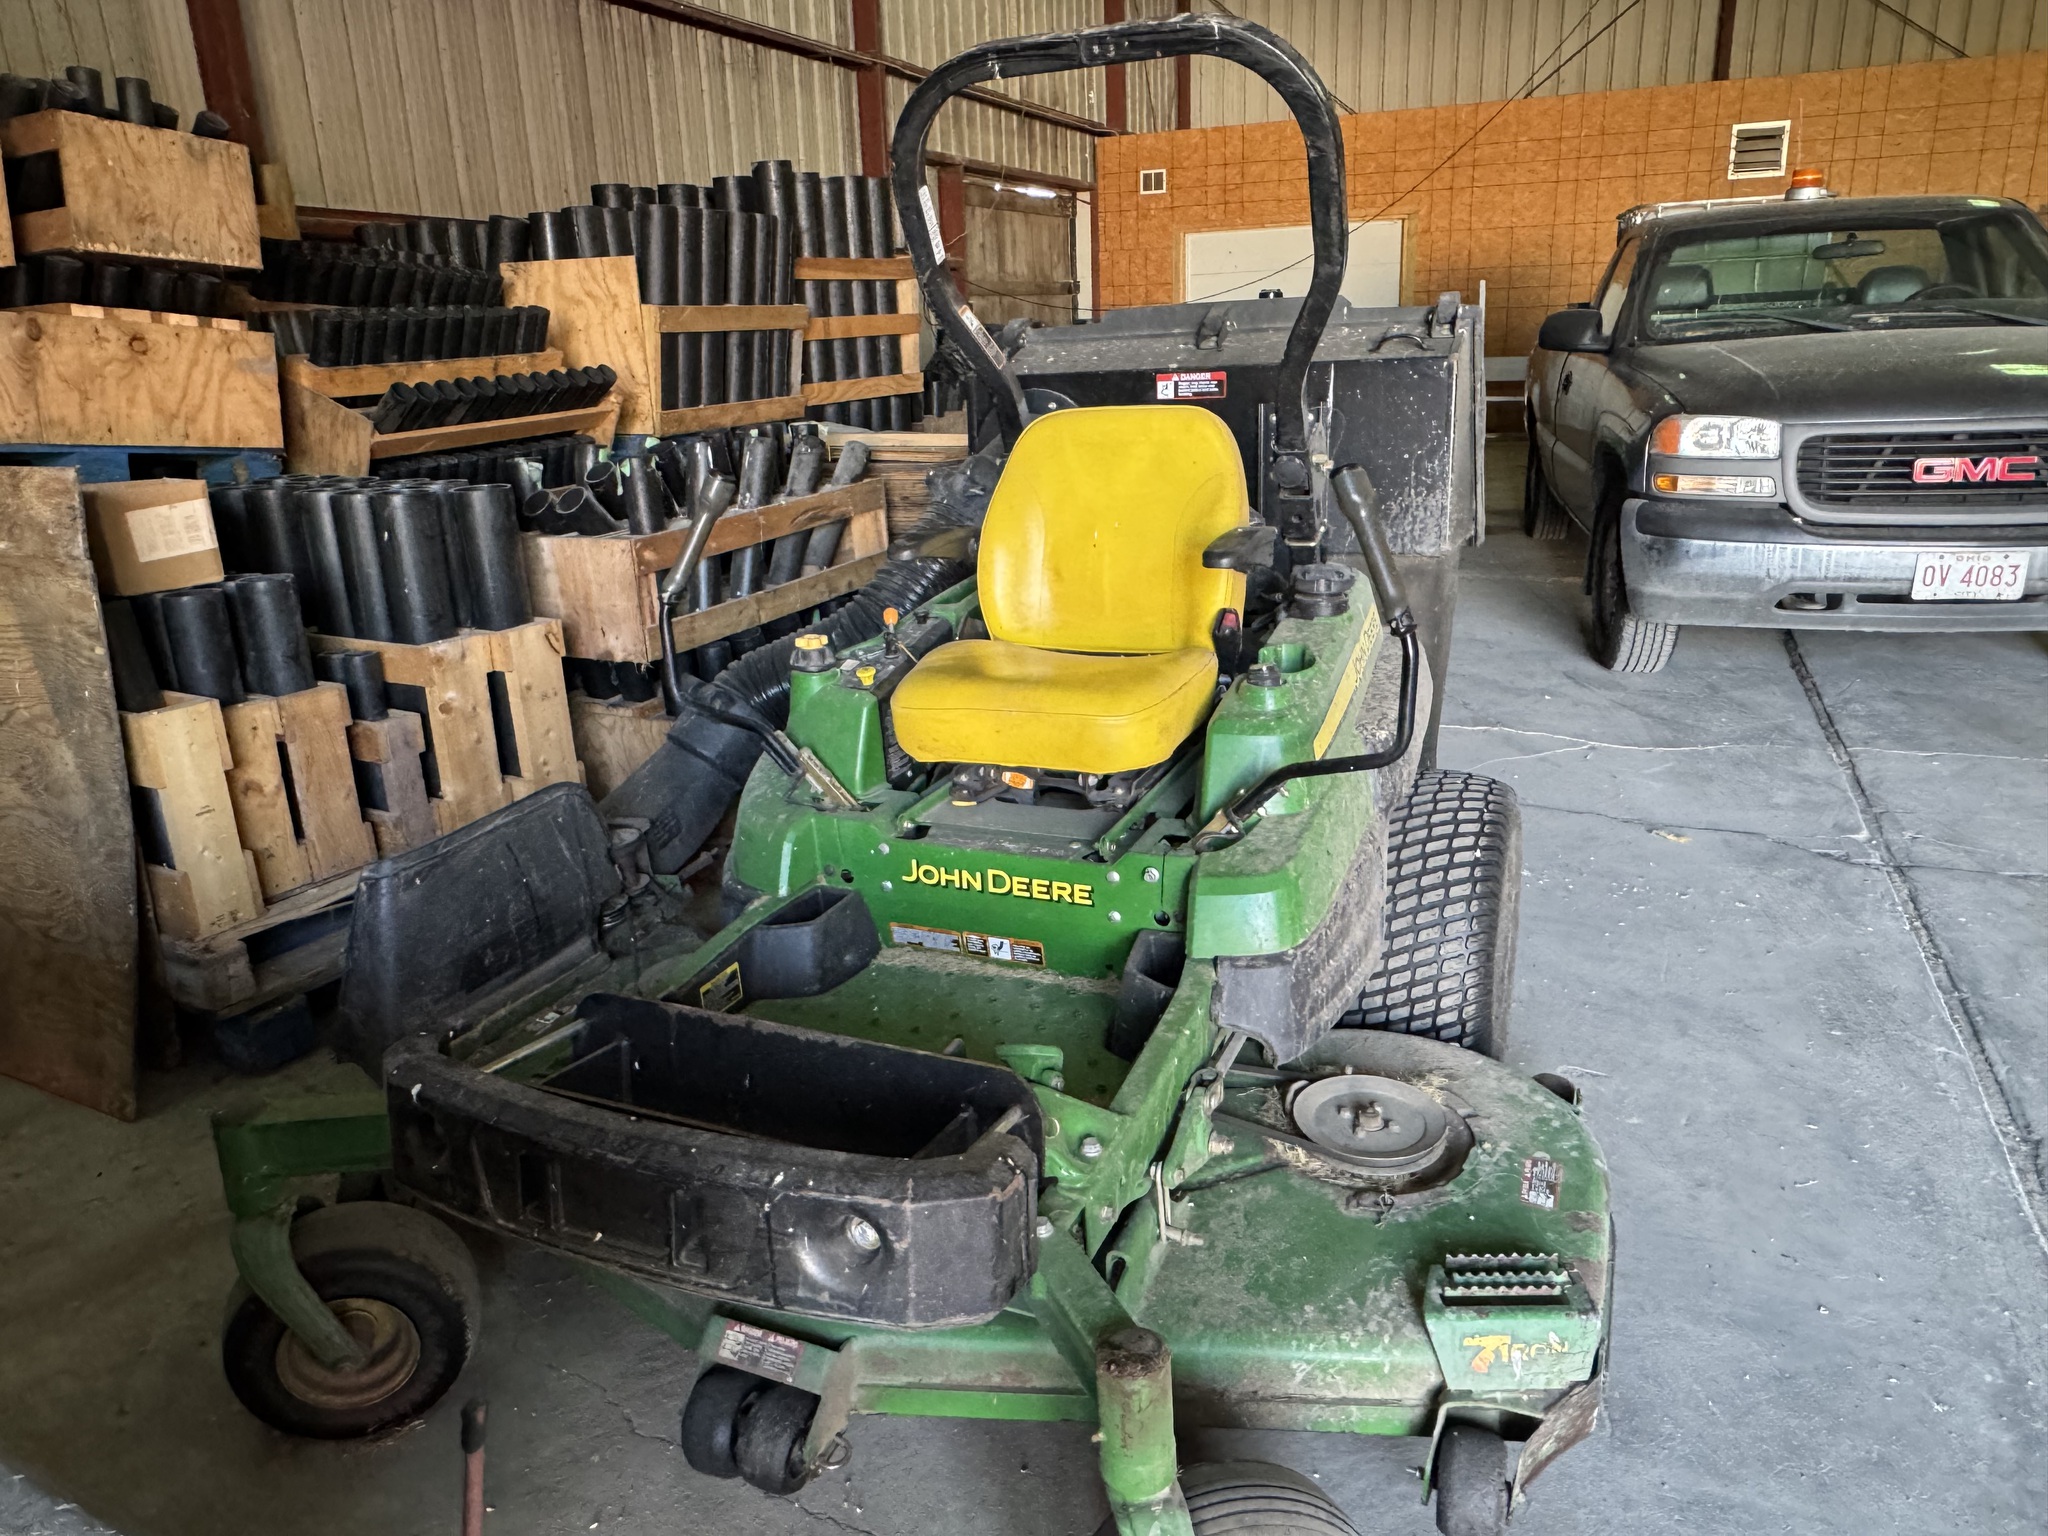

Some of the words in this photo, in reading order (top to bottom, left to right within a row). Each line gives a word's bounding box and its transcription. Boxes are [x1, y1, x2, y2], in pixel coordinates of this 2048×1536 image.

[1180, 372, 1211, 381] DANGER
[1913, 456, 2038, 483] GMC
[1956, 554, 1991, 562] OHIO
[1960, 564, 2021, 588] 4083
[902, 858, 983, 892] JOHN
[987, 868, 1094, 907] DEERE
